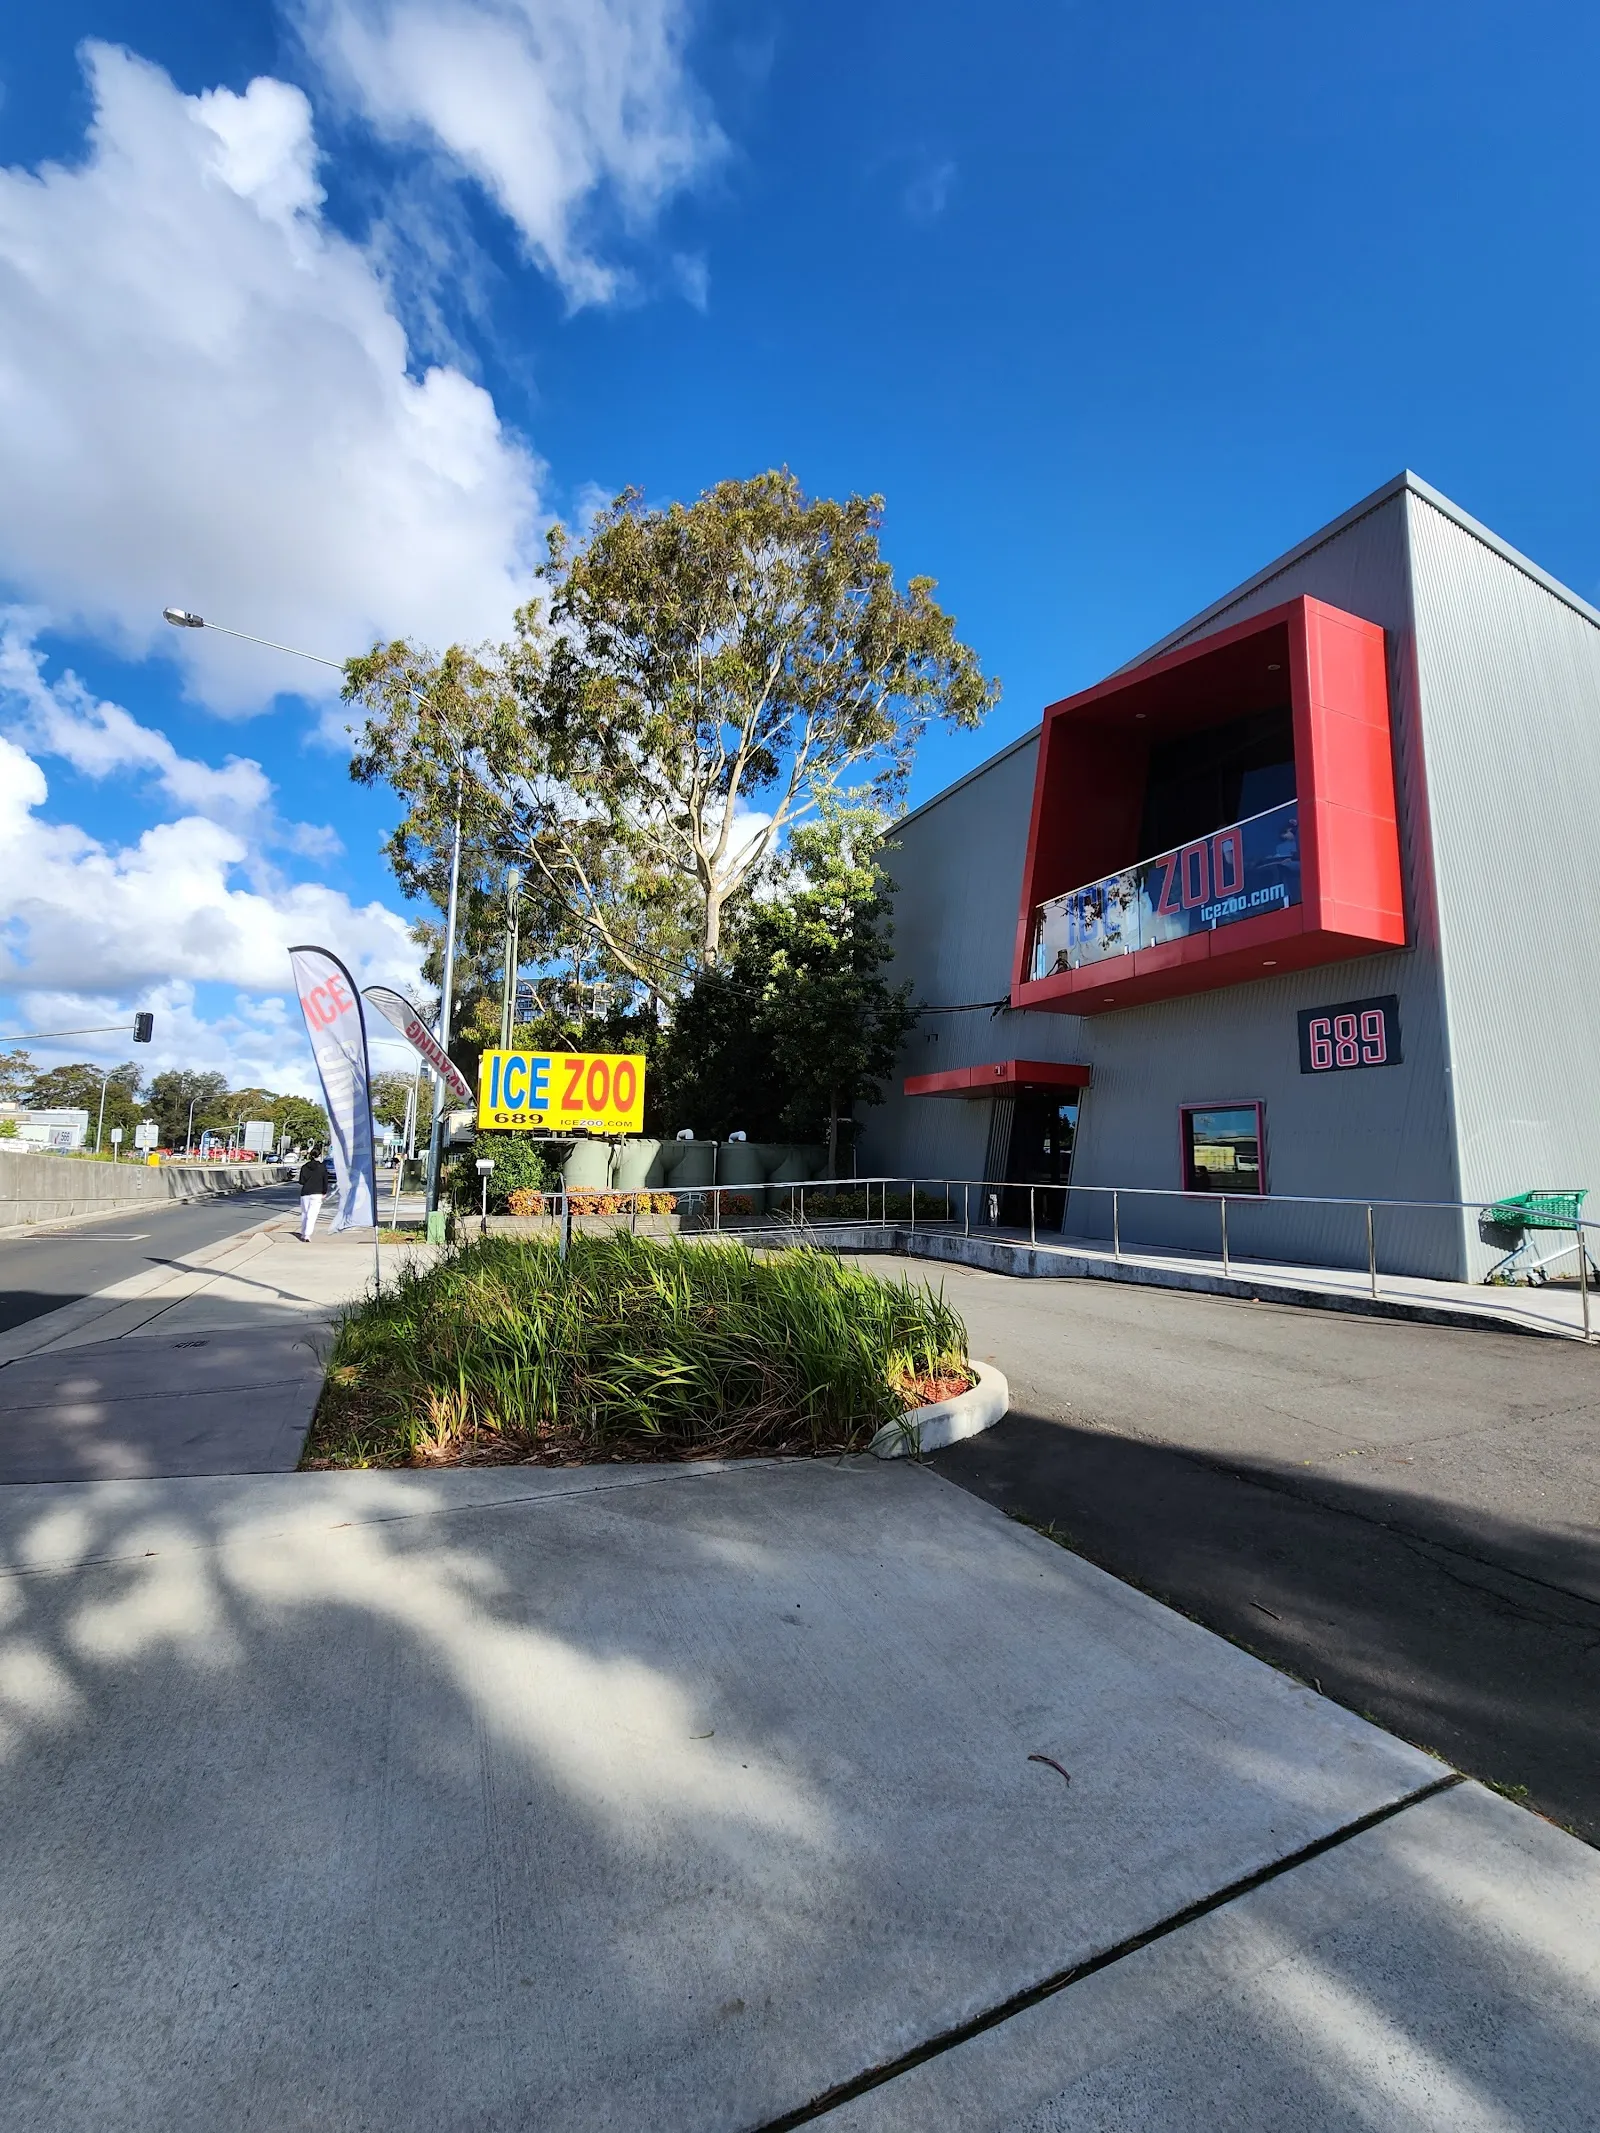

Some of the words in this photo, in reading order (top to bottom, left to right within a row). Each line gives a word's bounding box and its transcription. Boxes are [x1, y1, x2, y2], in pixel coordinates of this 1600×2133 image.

[1156, 826, 1245, 918] ZOO
[1201, 883, 1286, 923] icezoo.com
[300, 974, 354, 1032] ICE
[1309, 1009, 1387, 1070] 689
[489, 1056, 551, 1110] ICE
[561, 1058, 637, 1113] ZOO
[494, 1113, 544, 1125] 689
[560, 1119, 633, 1127] ICEZOO.COM
